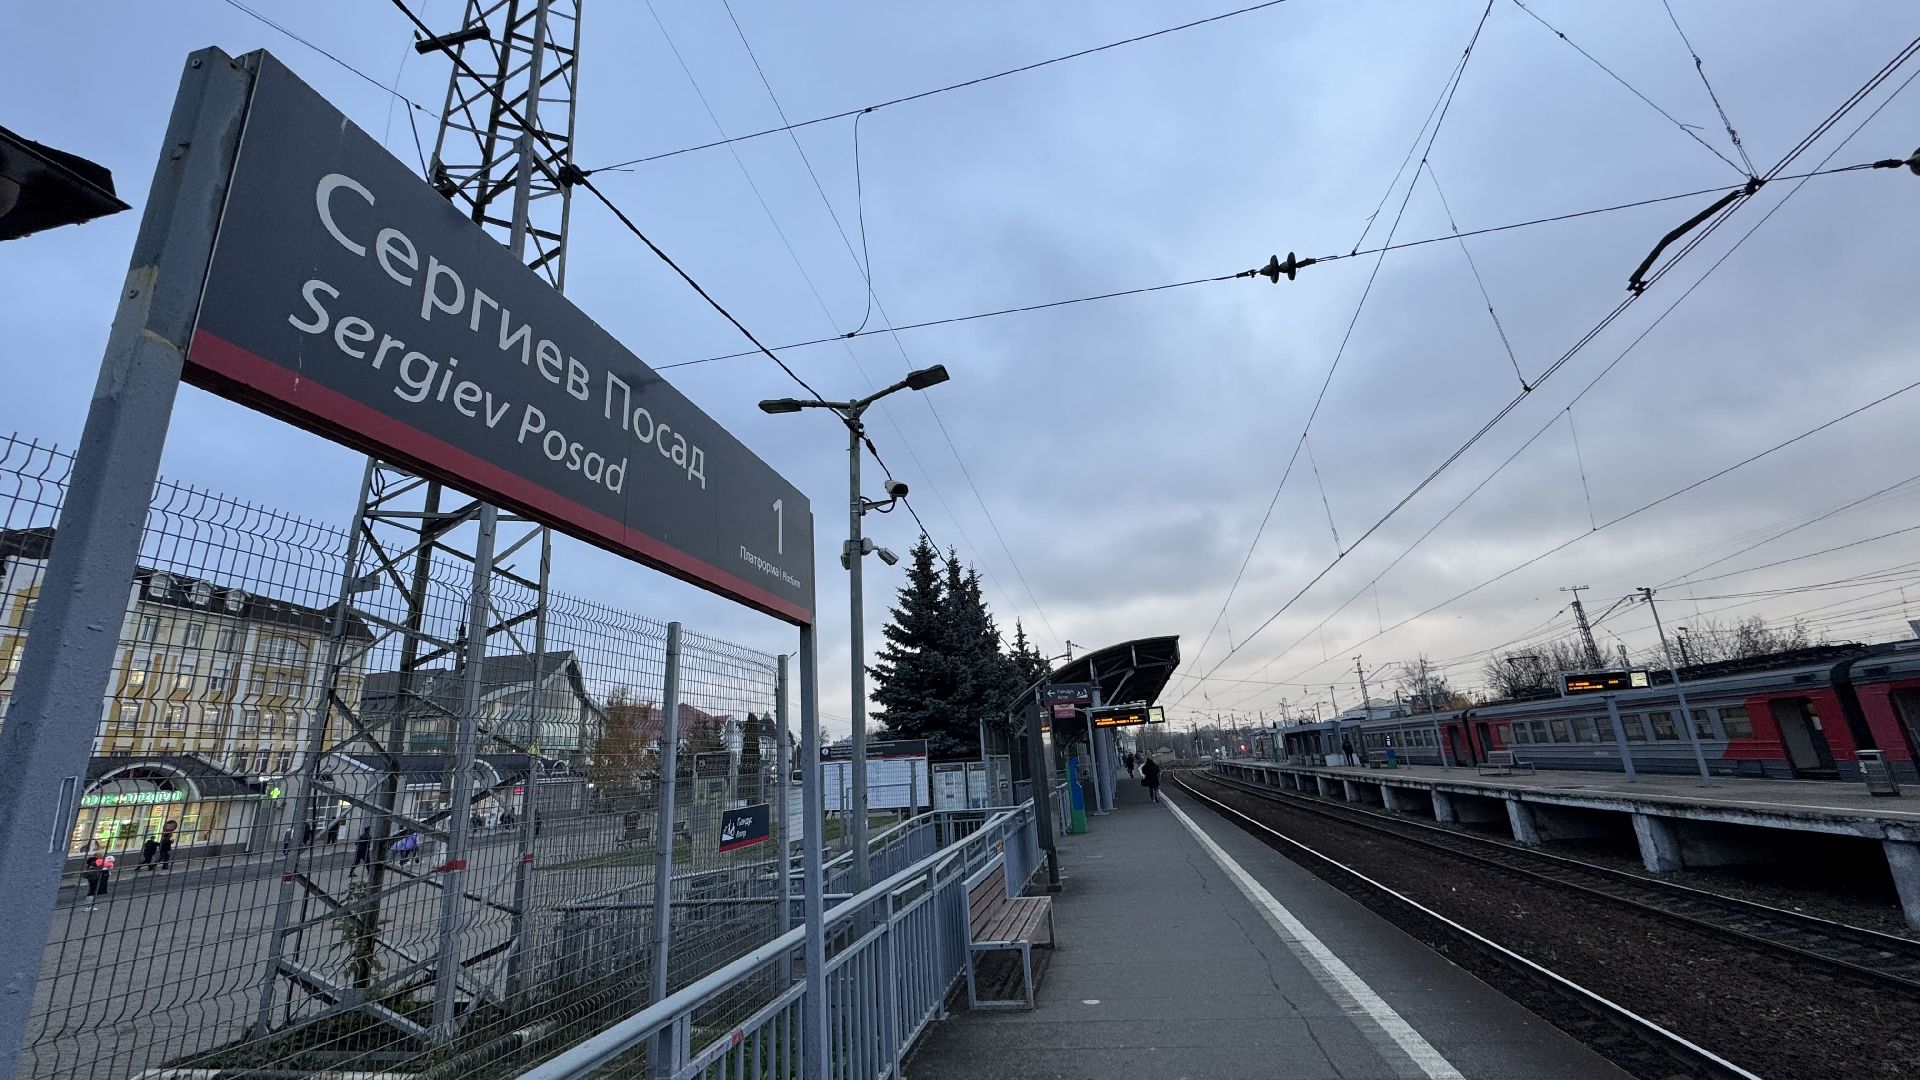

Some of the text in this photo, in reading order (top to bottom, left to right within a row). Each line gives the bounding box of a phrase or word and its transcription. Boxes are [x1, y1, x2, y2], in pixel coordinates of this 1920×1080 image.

[288, 279, 627, 494] Sergiev Posad
[316, 173, 706, 489] Сергиев Посад
[740, 545, 779, 577] Платформа
[773, 499, 783, 555] 1
